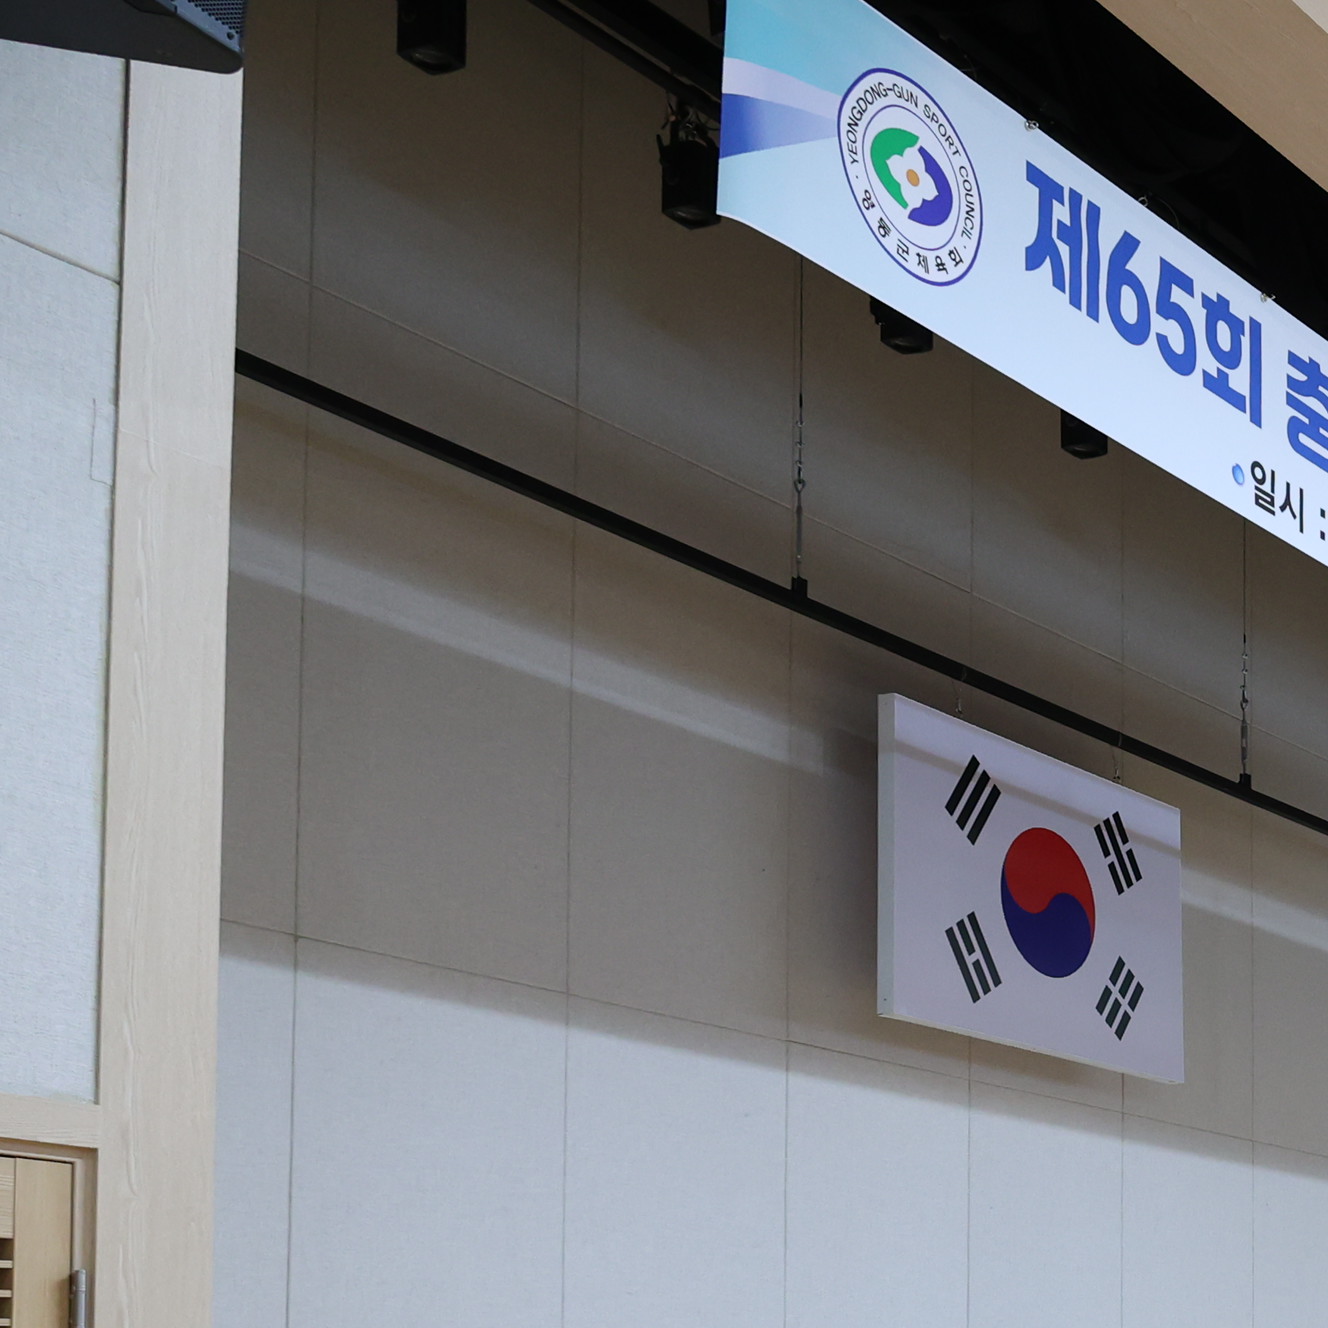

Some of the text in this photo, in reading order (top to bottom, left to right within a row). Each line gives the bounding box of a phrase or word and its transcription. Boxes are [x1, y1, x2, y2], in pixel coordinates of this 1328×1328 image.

[846, 81, 975, 240] YEONGDONG-GUN SPORT COUNCIL
[1025, 160, 1262, 429] 제65회
[1250, 461, 1304, 533] 일시
